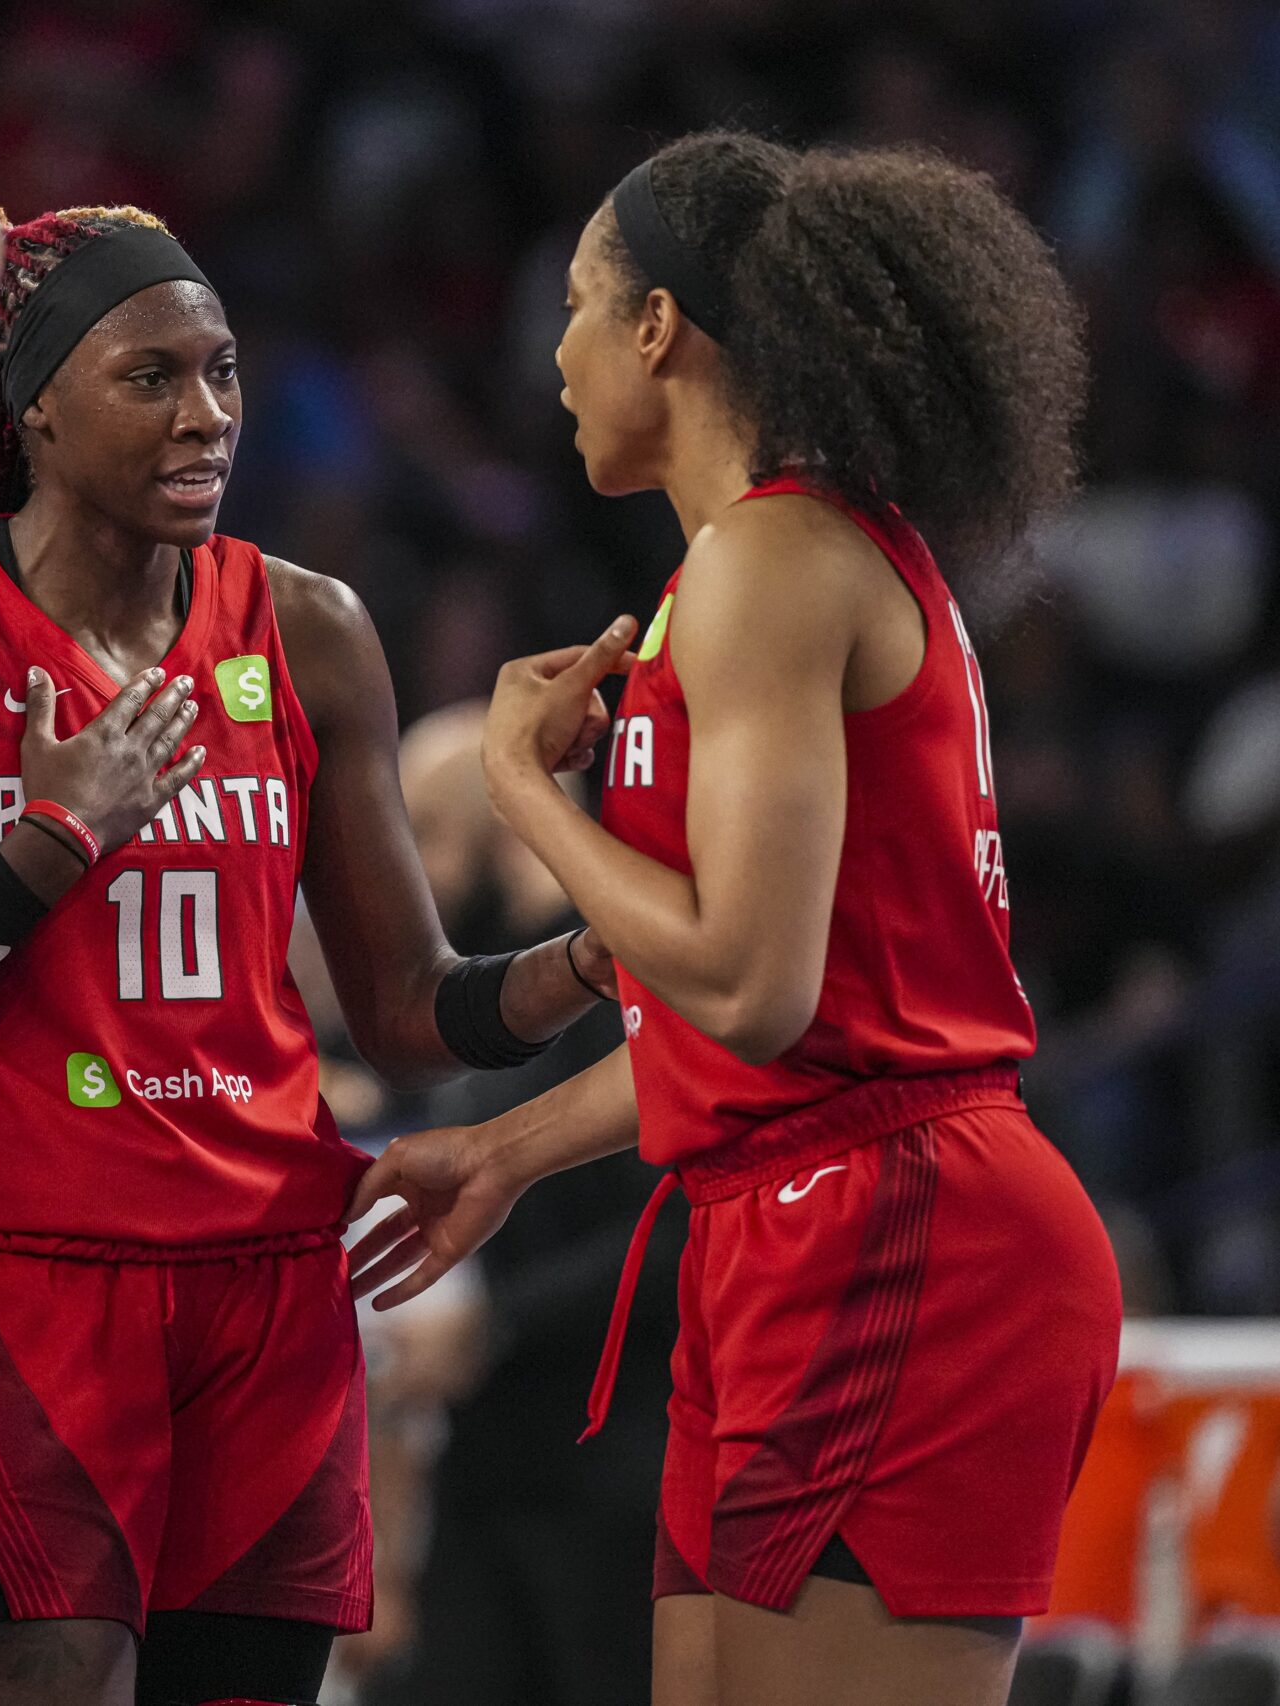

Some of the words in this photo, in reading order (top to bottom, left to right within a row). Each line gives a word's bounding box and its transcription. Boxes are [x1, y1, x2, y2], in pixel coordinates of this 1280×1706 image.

[107, 868, 224, 1000] 10
[126, 1068, 203, 1100] Cash
[211, 1067, 253, 1104] App
